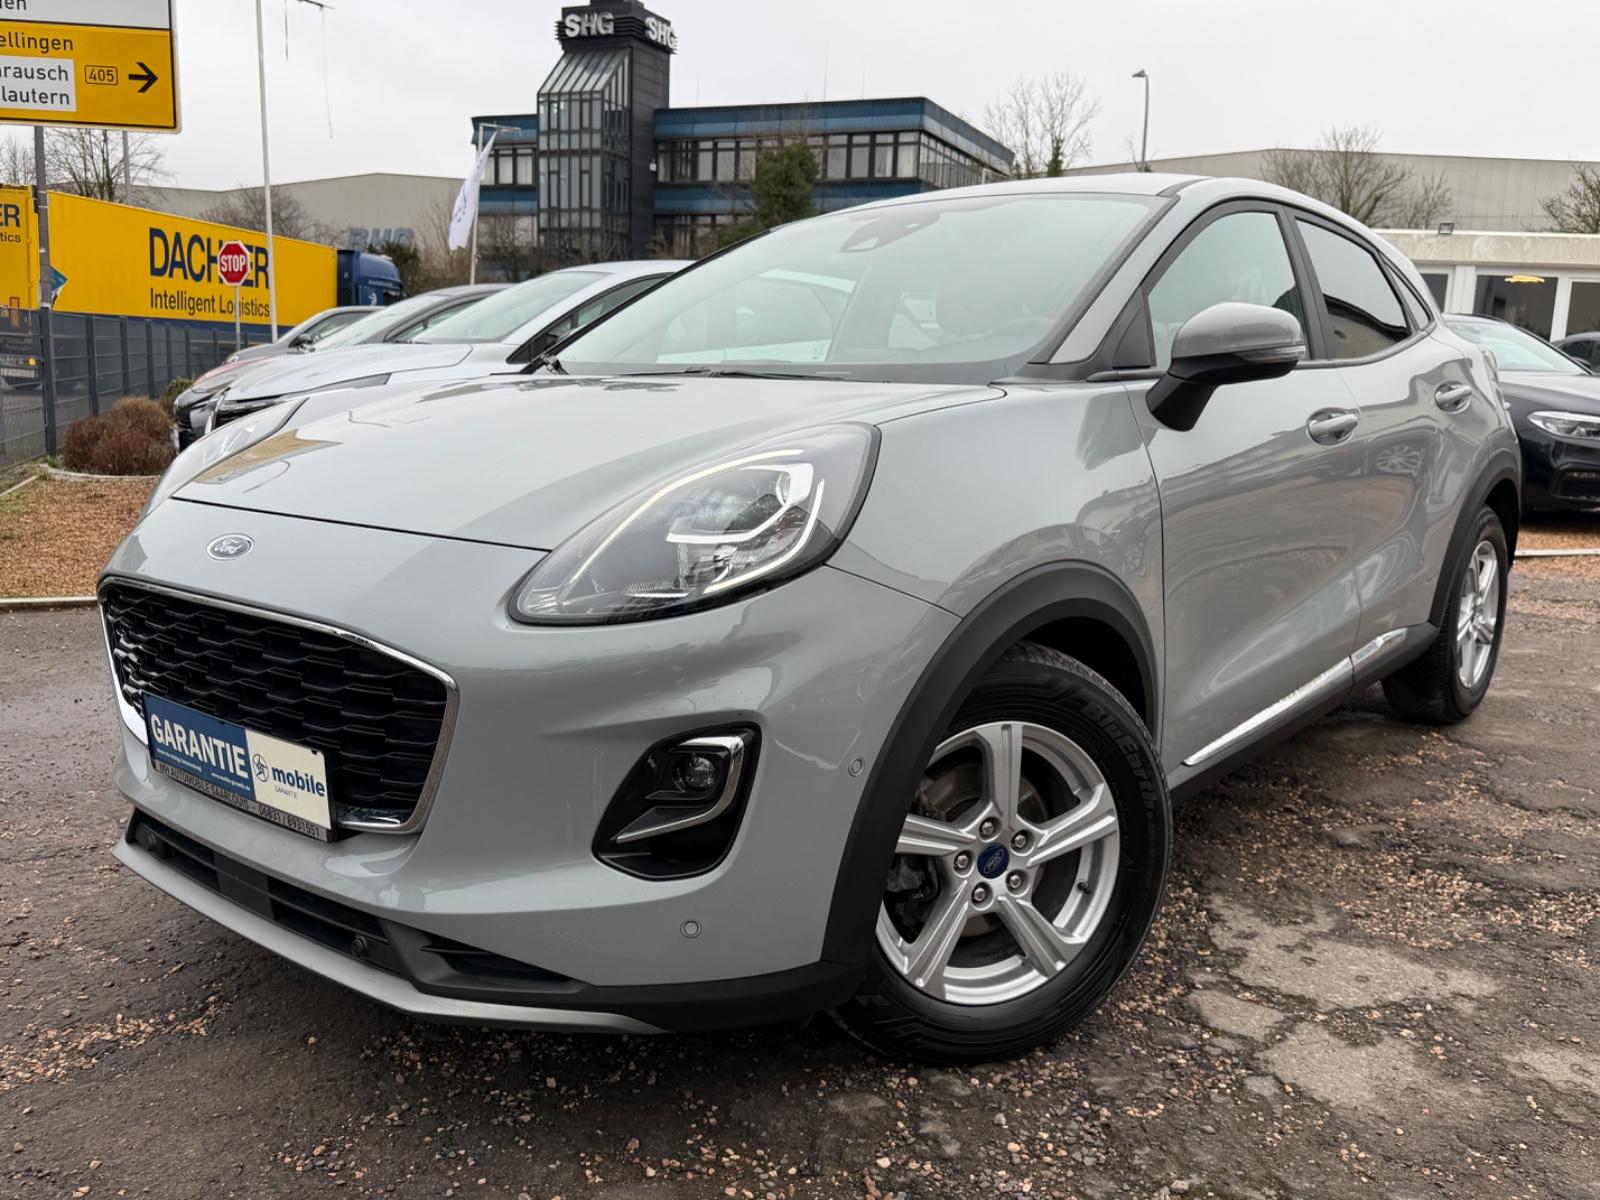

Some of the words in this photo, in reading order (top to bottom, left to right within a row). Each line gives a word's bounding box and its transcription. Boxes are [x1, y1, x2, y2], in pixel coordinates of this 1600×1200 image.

[565, 11, 614, 38] SHG
[89, 68, 115, 83] 405
[149, 226, 269, 289] DACHER
[221, 254, 246, 273] STOP
[150, 287, 216, 316] Intelligent
[220, 294, 270, 318] Loistics
[151, 714, 249, 779] GARANTIE
[272, 766, 326, 797] mobile
[274, 785, 298, 799] GARANTIE
[172, 766, 210, 793] AUTOMOBILE
[211, 783, 250, 810] SAARLOUIS
[286, 814, 320, 837] 8931551
